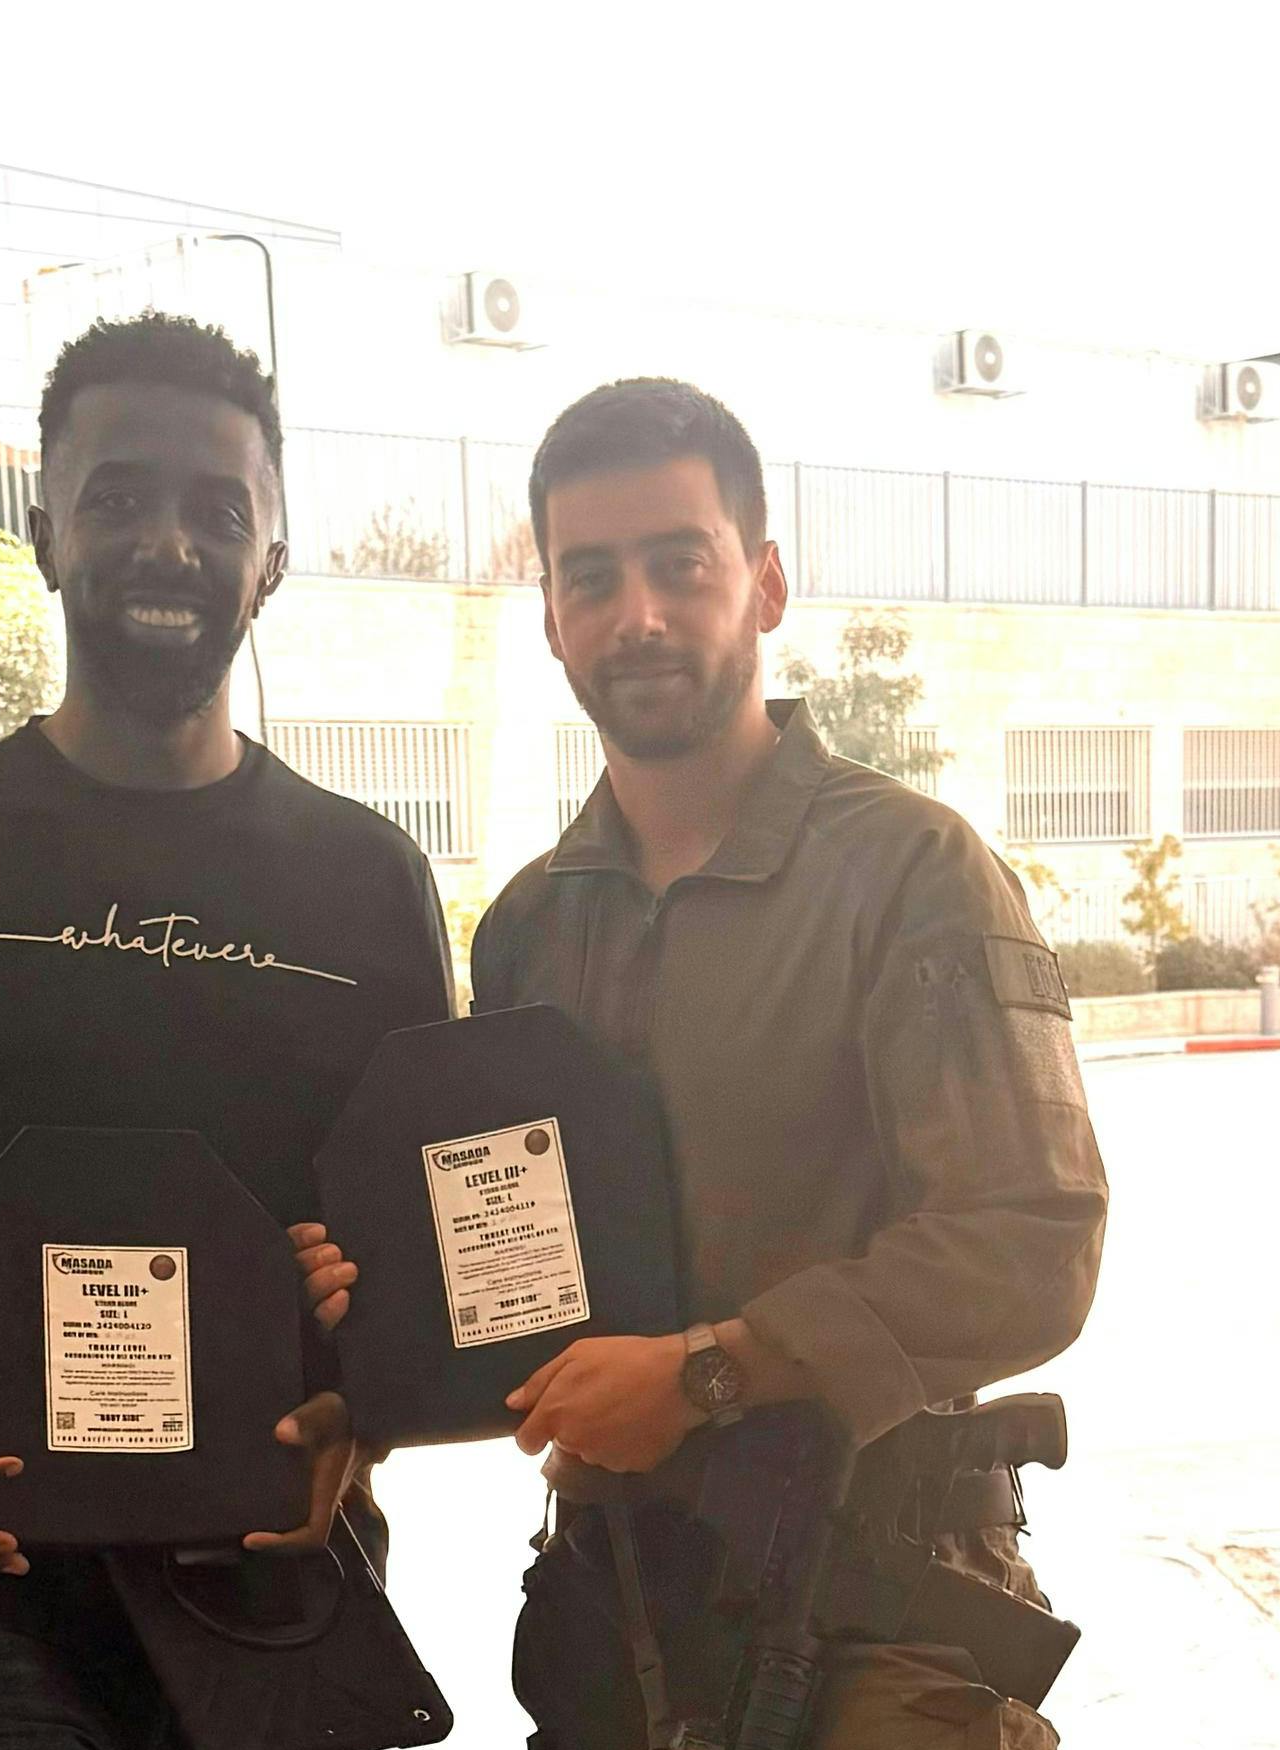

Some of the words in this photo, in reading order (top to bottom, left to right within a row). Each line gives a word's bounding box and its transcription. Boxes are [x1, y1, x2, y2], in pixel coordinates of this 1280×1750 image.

[441, 1146, 490, 1165] MASADA
[465, 1169, 502, 1188] LEVEL
[504, 1165, 528, 1180] III+
[61, 1257, 113, 1270] MASADA
[82, 1283, 121, 1297] LEVEL
[124, 1284, 149, 1297] III+
